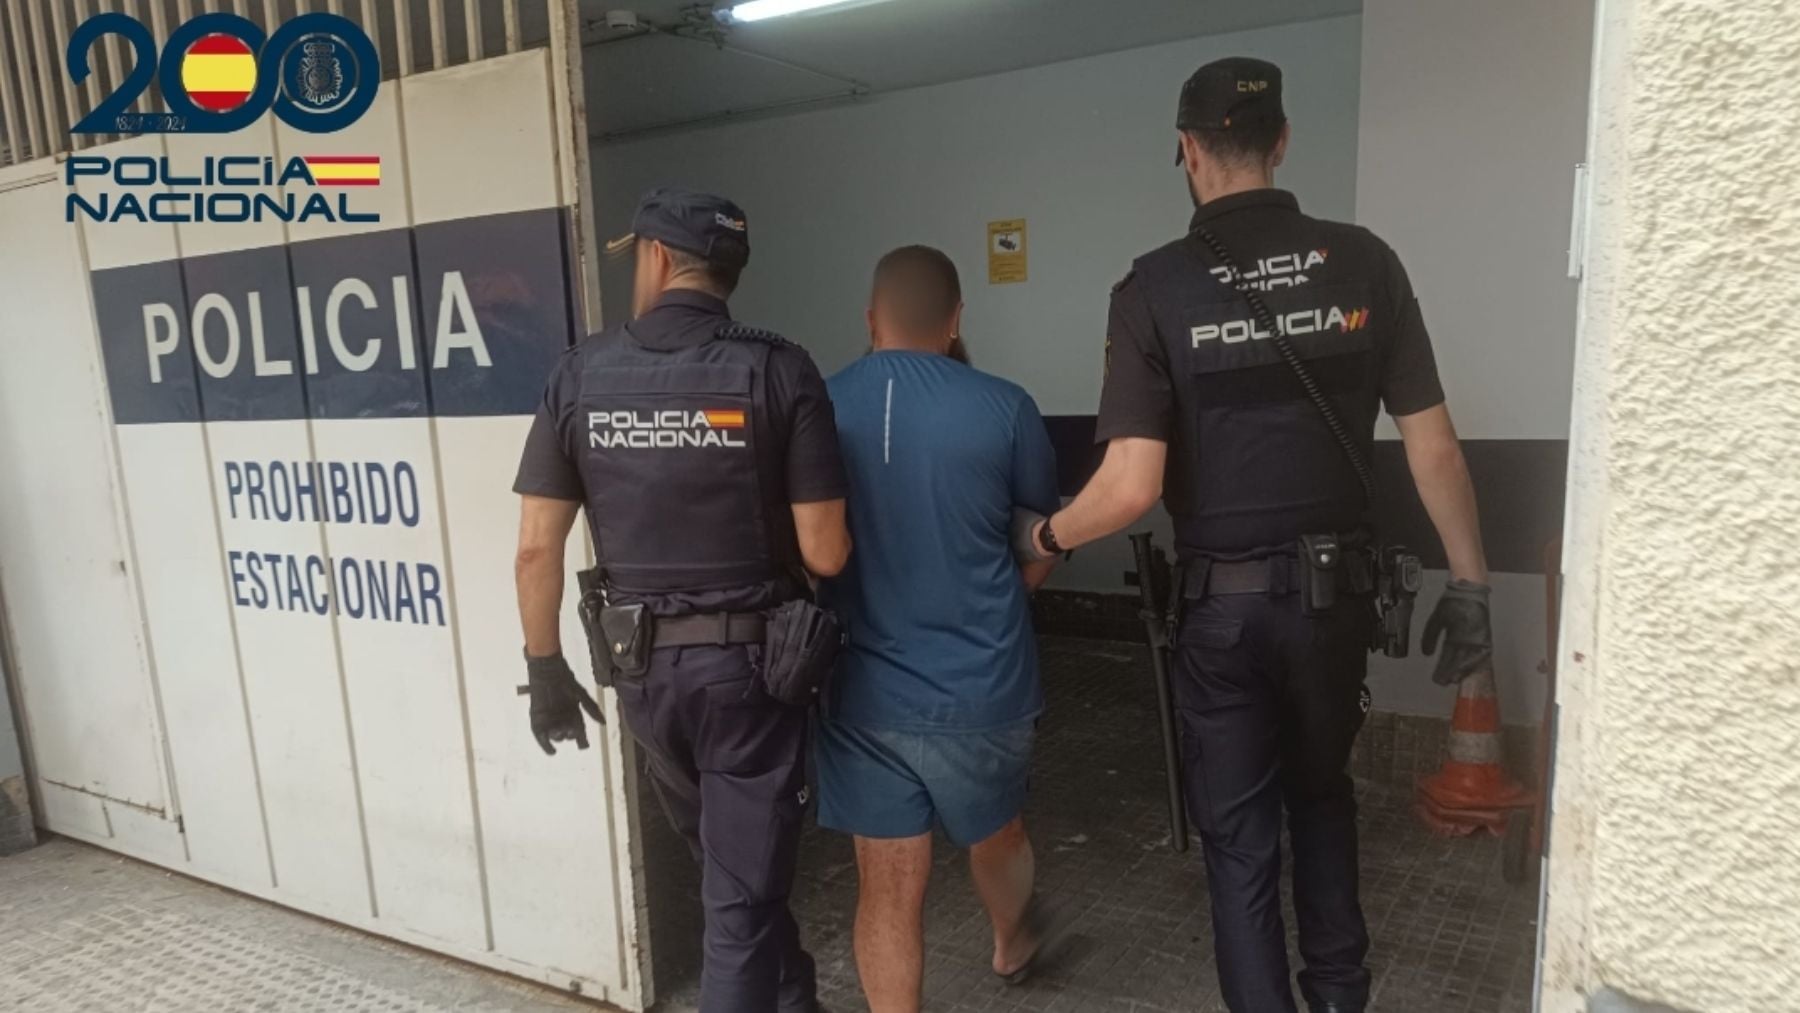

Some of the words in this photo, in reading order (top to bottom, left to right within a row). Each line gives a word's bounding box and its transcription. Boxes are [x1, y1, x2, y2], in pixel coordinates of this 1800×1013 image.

[1237, 80, 1268, 92] CNP
[142, 270, 493, 384] POLICIA
[1190, 306, 1347, 349] POLICIA
[588, 410, 711, 429] POLICIA
[589, 429, 746, 449] NACIONAL
[224, 460, 421, 528] PROHIBIDO
[228, 550, 447, 627] ESTACIONAR
